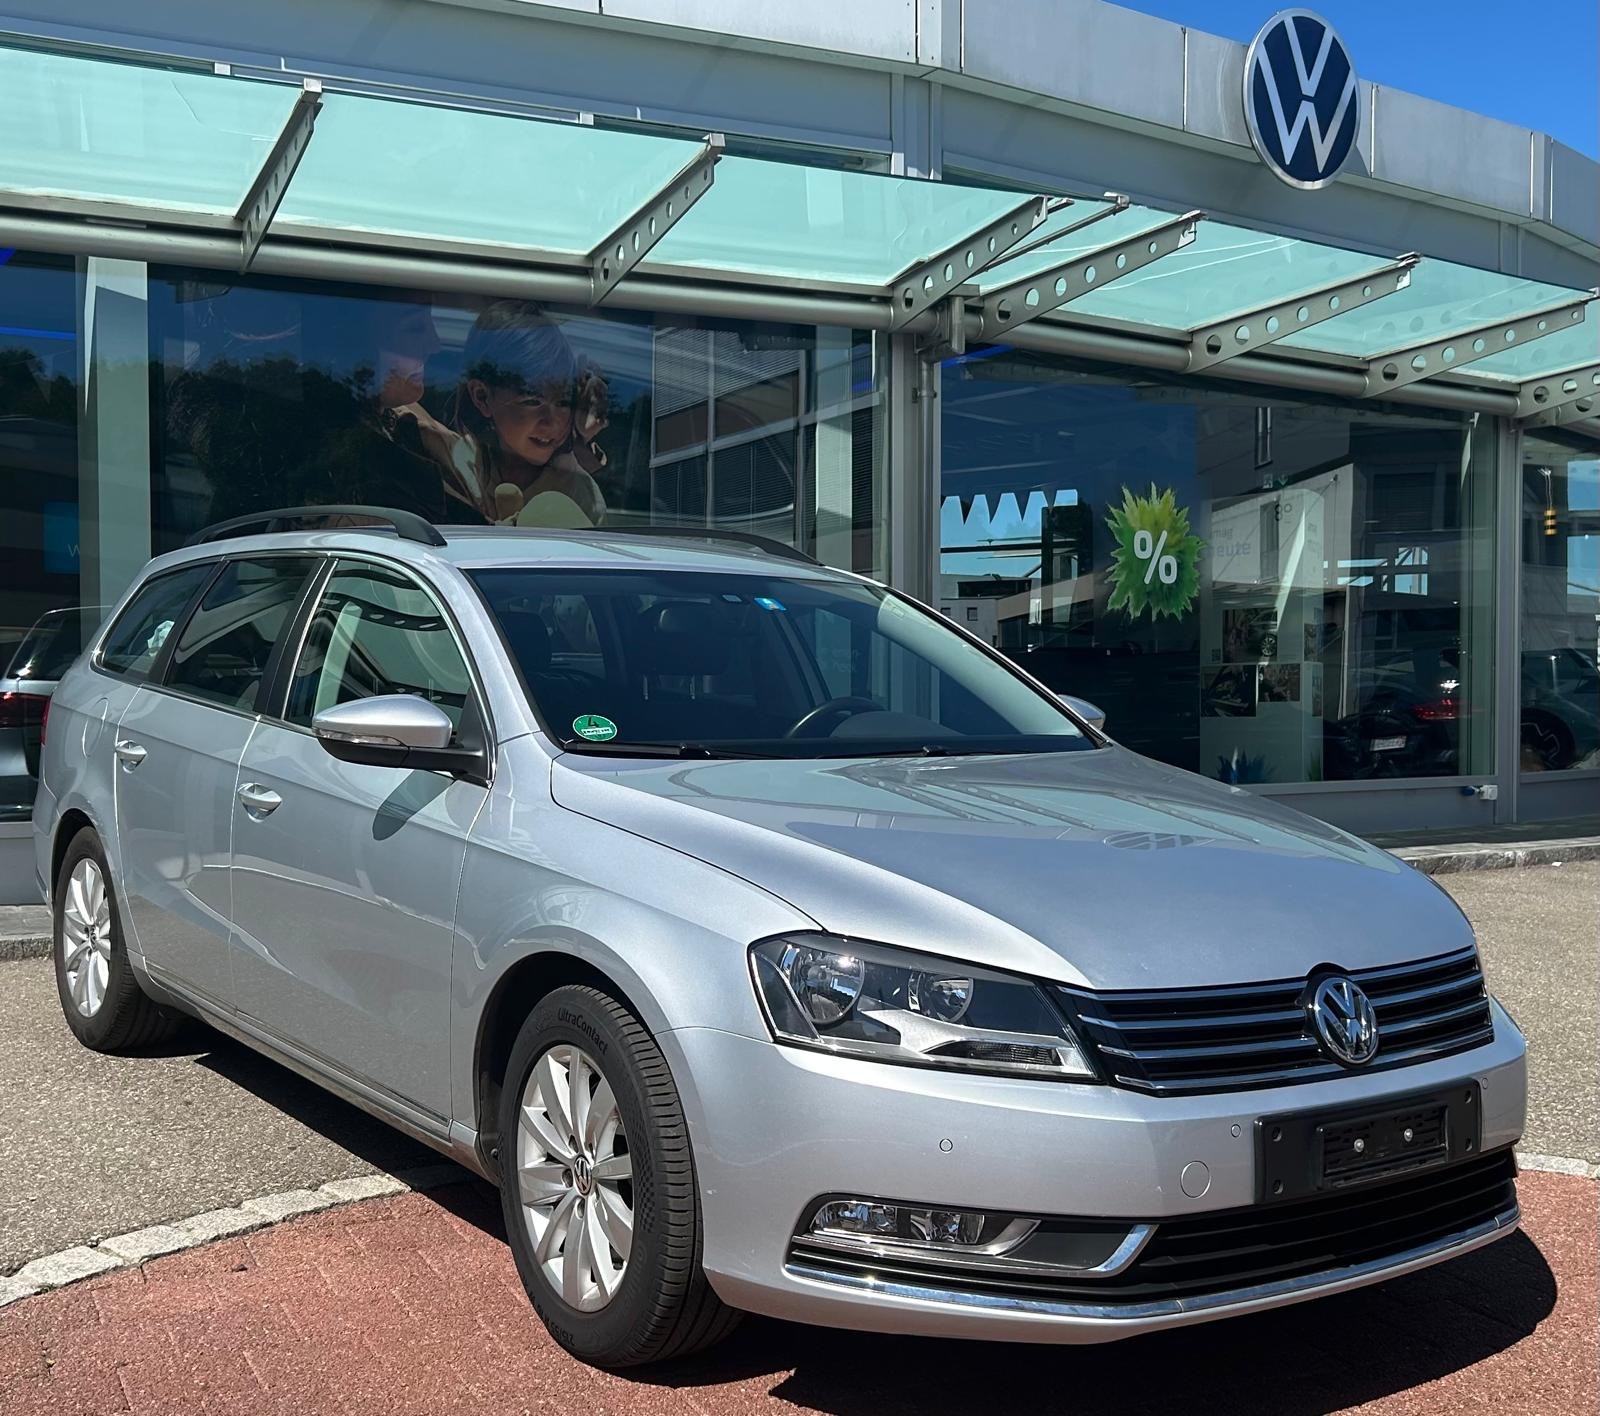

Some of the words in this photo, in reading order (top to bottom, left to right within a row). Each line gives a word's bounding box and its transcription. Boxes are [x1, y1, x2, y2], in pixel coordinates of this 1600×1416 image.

[1251, 12, 1357, 178] VW
[1133, 529, 1178, 585] %
[557, 1007, 609, 1056] UltraContact
[1315, 977, 1377, 1064] VW
